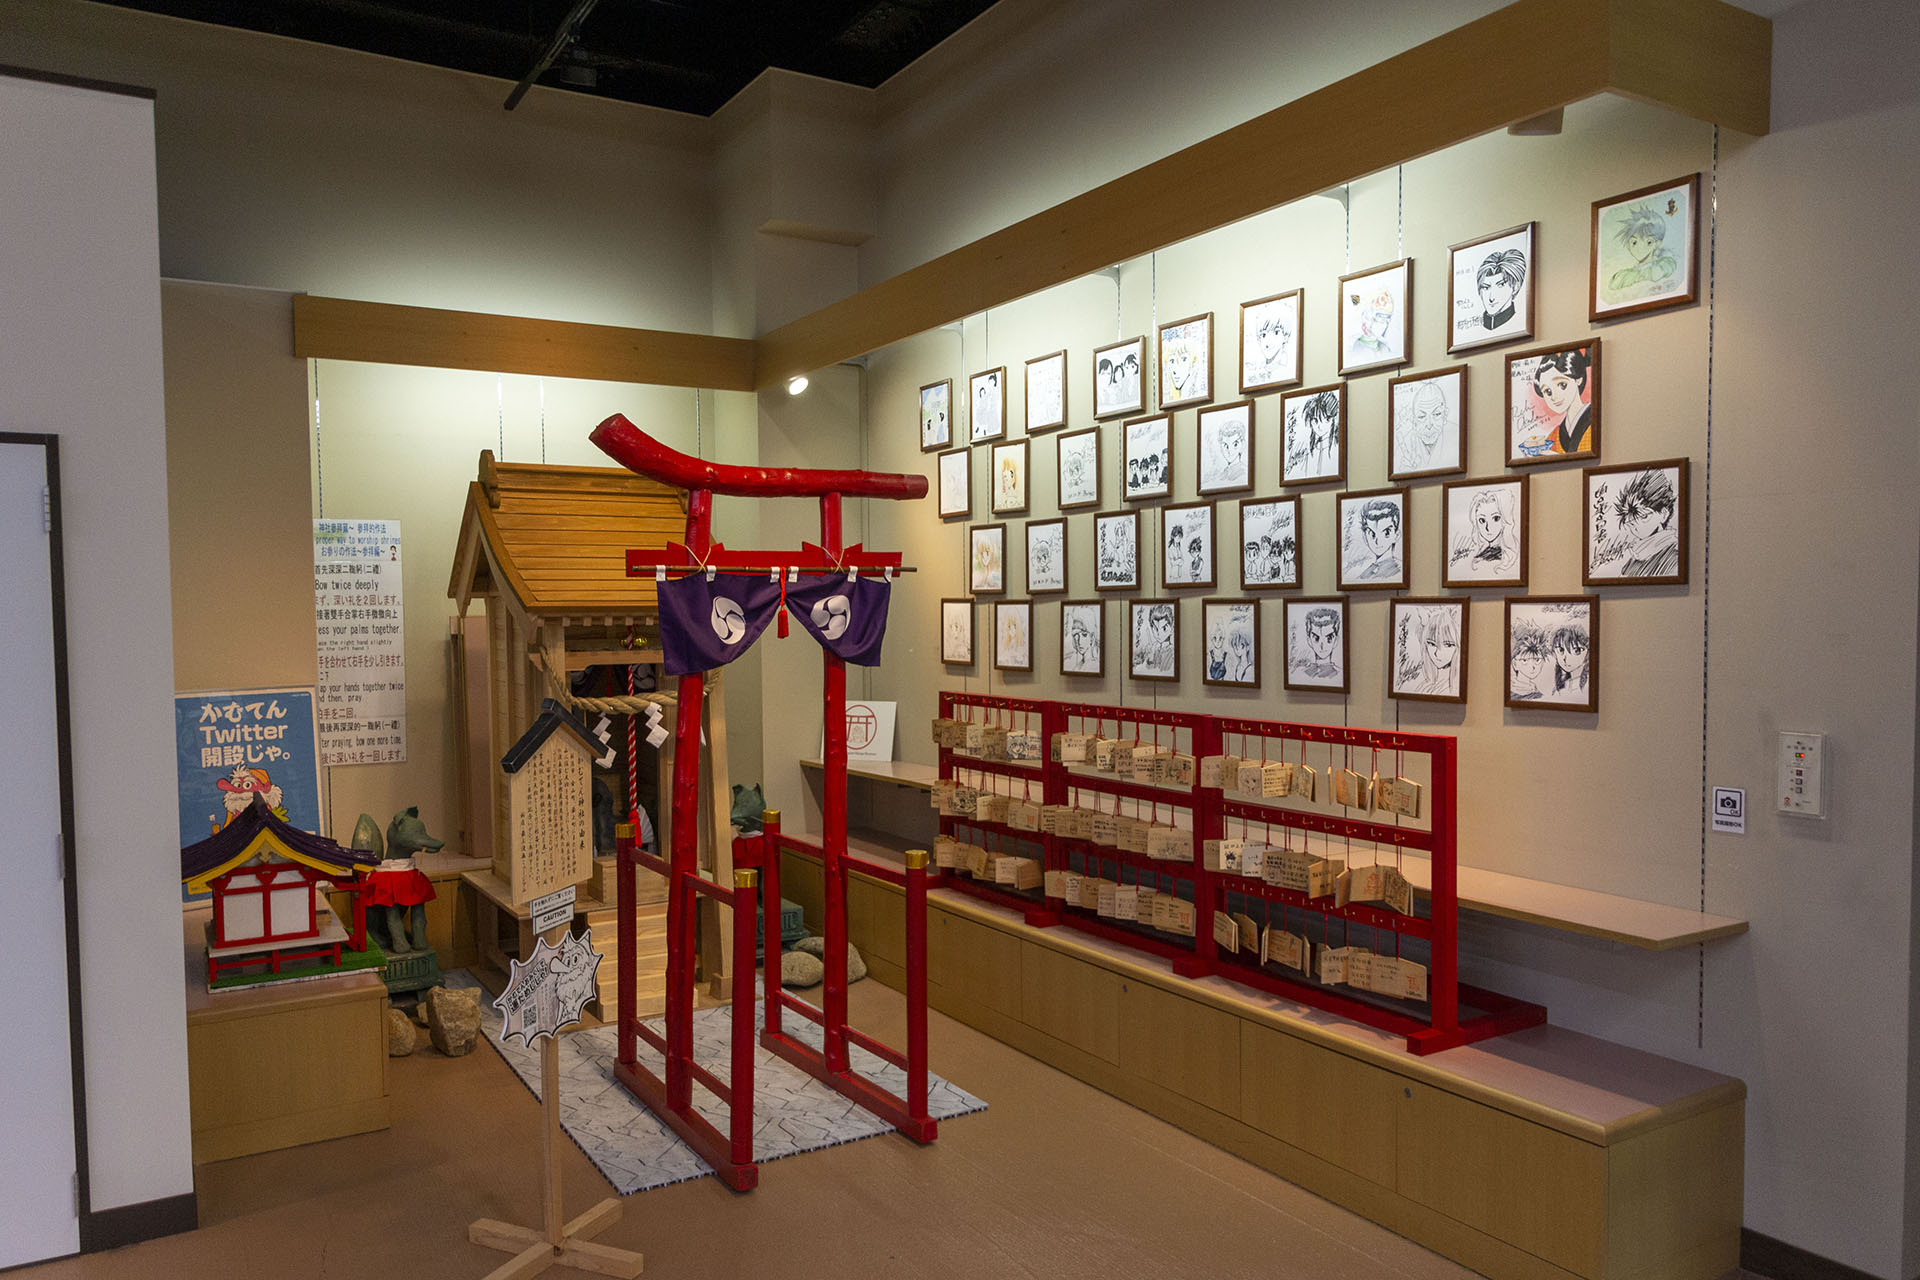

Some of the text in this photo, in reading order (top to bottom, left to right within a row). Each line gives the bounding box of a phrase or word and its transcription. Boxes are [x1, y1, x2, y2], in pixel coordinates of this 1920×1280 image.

[336, 536, 346, 546] way
[349, 536, 355, 544] to
[358, 536, 378, 545] worship
[314, 579, 379, 591] Bow twice deeply
[317, 626, 329, 635] ess
[333, 626, 347, 636] your
[350, 624, 369, 636] palms
[329, 684, 341, 693] your
[344, 683, 360, 692] hands
[362, 682, 386, 692] together
[389, 682, 404, 691] twice
[199, 700, 288, 724] かむてん
[199, 723, 288, 744] Twitter
[377, 736, 388, 745] more
[201, 744, 290, 768] 開設じゃ。
[543, 909, 566, 922] CAUTION
